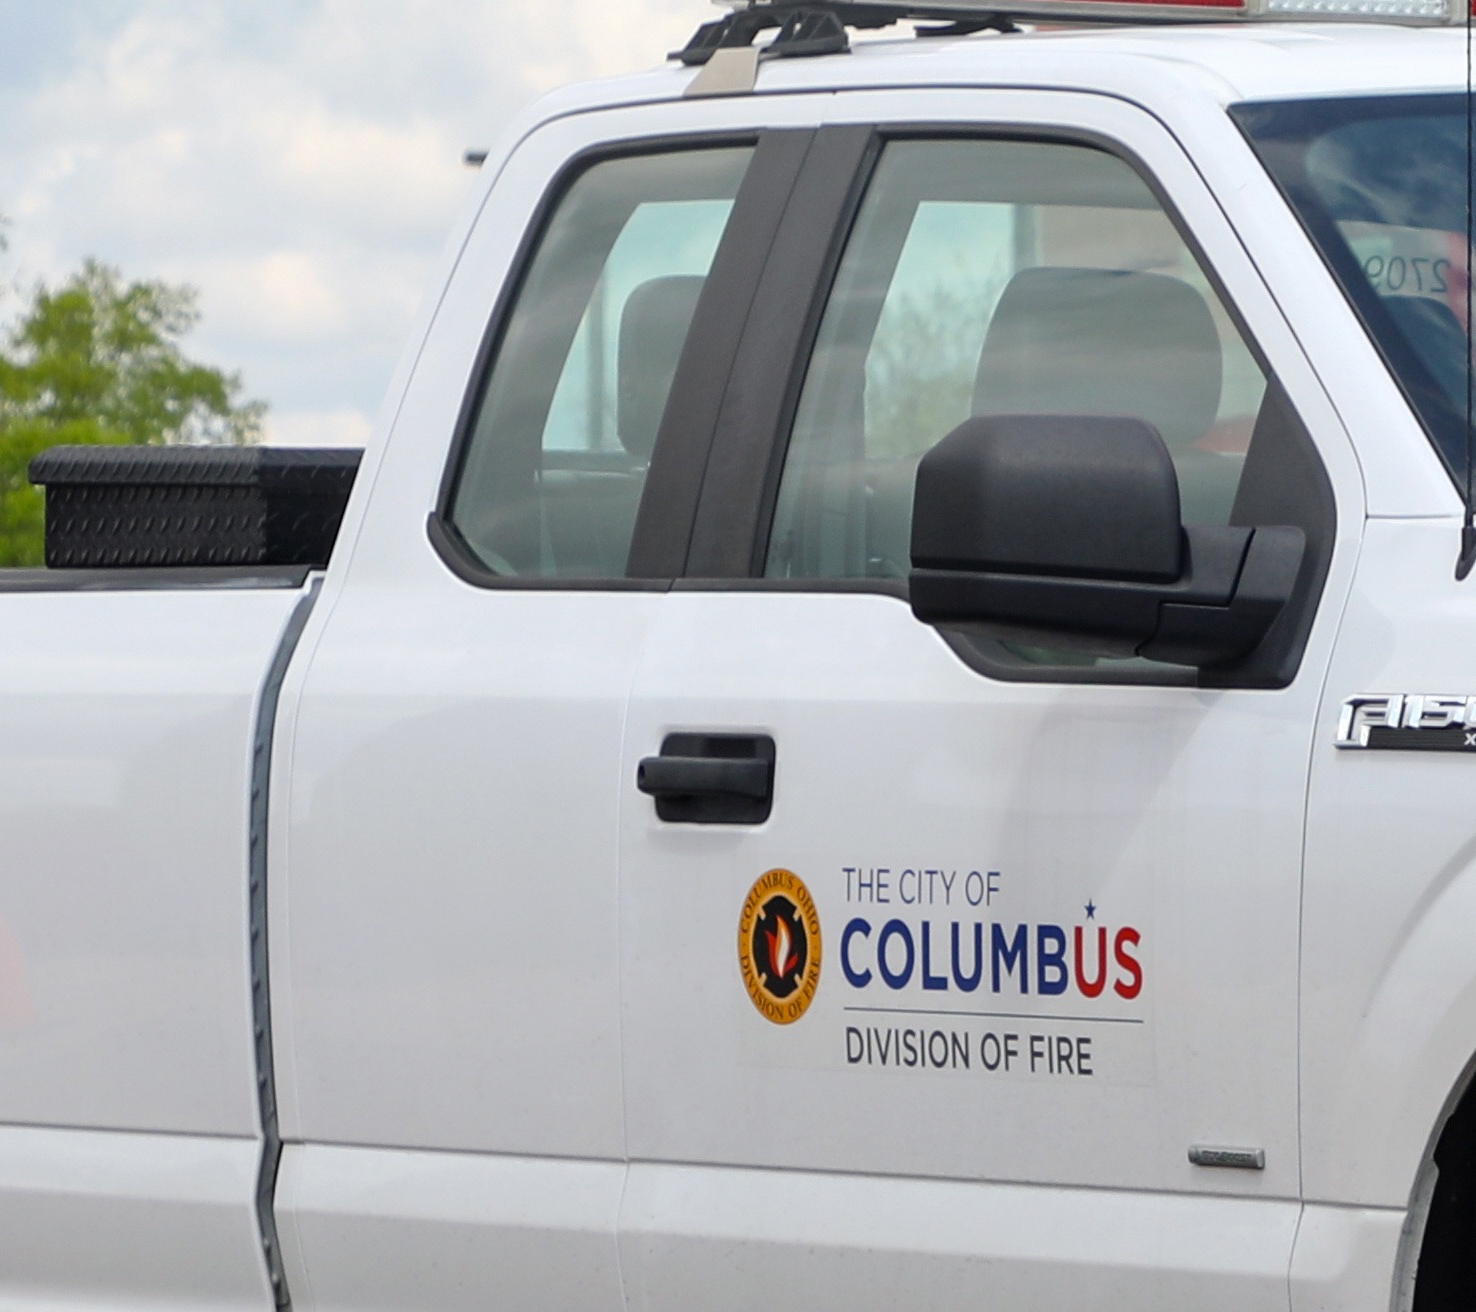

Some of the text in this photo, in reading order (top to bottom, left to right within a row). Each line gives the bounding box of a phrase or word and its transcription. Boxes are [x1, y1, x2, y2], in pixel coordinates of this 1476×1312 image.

[740, 871, 821, 936] COLUMBUS OHIO
[842, 867, 1001, 907] THE CITY OF
[740, 953, 821, 1020] DIVISION OF FIRE
[840, 916, 1144, 1001] COLUMBUS
[844, 1026, 1094, 1077] DIVISION OF FIRE
